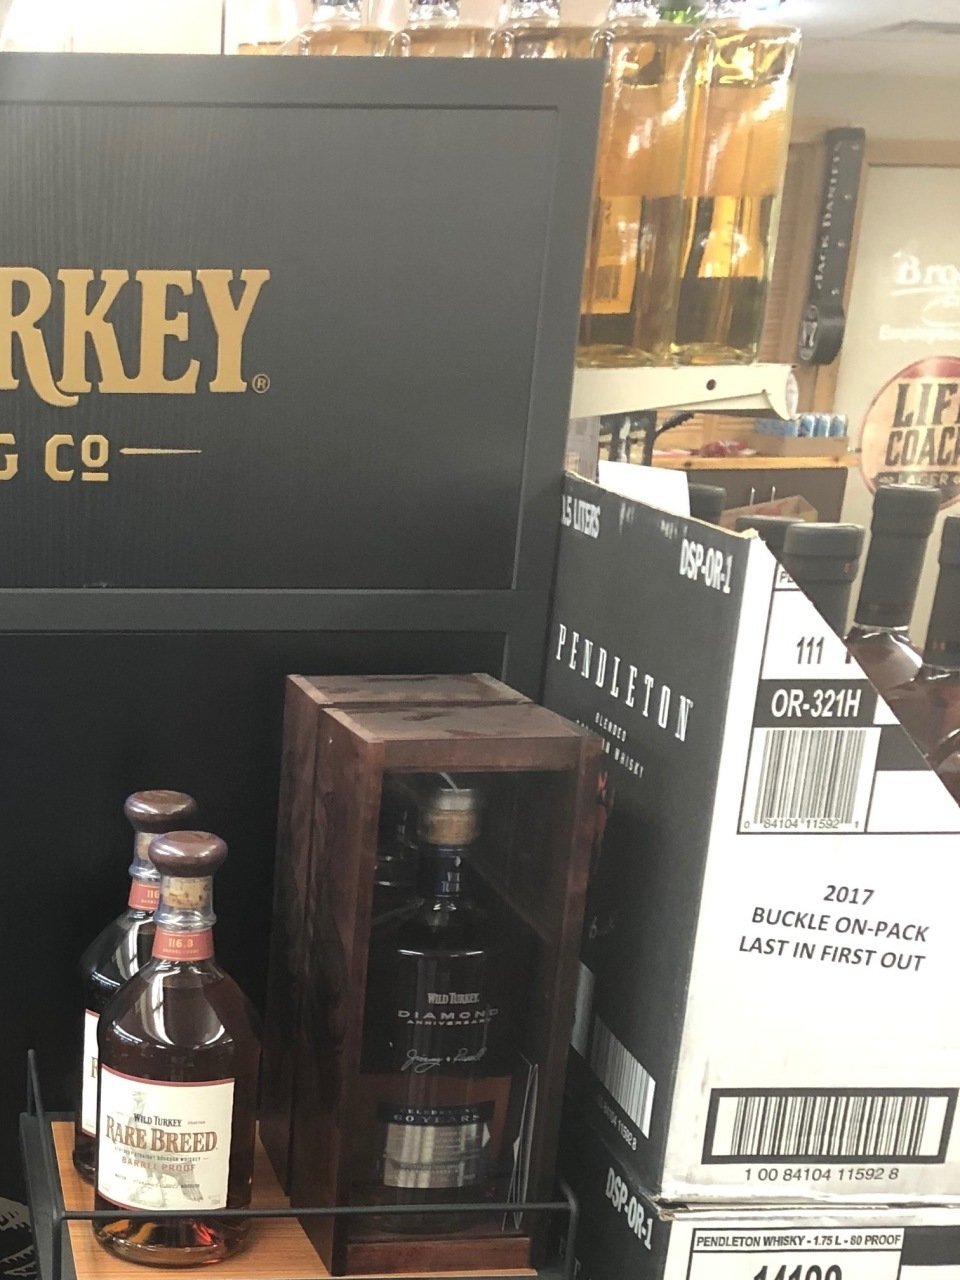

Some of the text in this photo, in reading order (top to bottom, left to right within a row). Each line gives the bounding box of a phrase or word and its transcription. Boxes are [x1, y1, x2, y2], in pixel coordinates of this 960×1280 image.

[893, 383, 960, 427] LIF
[573, 498, 601, 538] LITERS
[679, 537, 733, 594] DSP-OR-1
[797, 636, 824, 664] 111
[556, 623, 693, 742] PENDLETON
[771, 689, 862, 718] OR-321H
[824, 884, 875, 906] 2017
[751, 907, 930, 942] BUCKLE ON-PACK
[739, 935, 926, 971] LAST IN FIRST OUT
[398, 1009, 499, 1020] DIAMOND
[106, 1114, 218, 1153] RARE BREED
[133, 1113, 182, 1127] WILD TURKEY
[758, 1167, 886, 1181] 00 84104 11592
[606, 1167, 653, 1250] DSP-OR-1
[696, 1236, 761, 1247] PENDLETON
[763, 1235, 805, 1247] WHISKY
[814, 1235, 833, 1246] 1.75
[864, 1234, 901, 1245] PROOF
